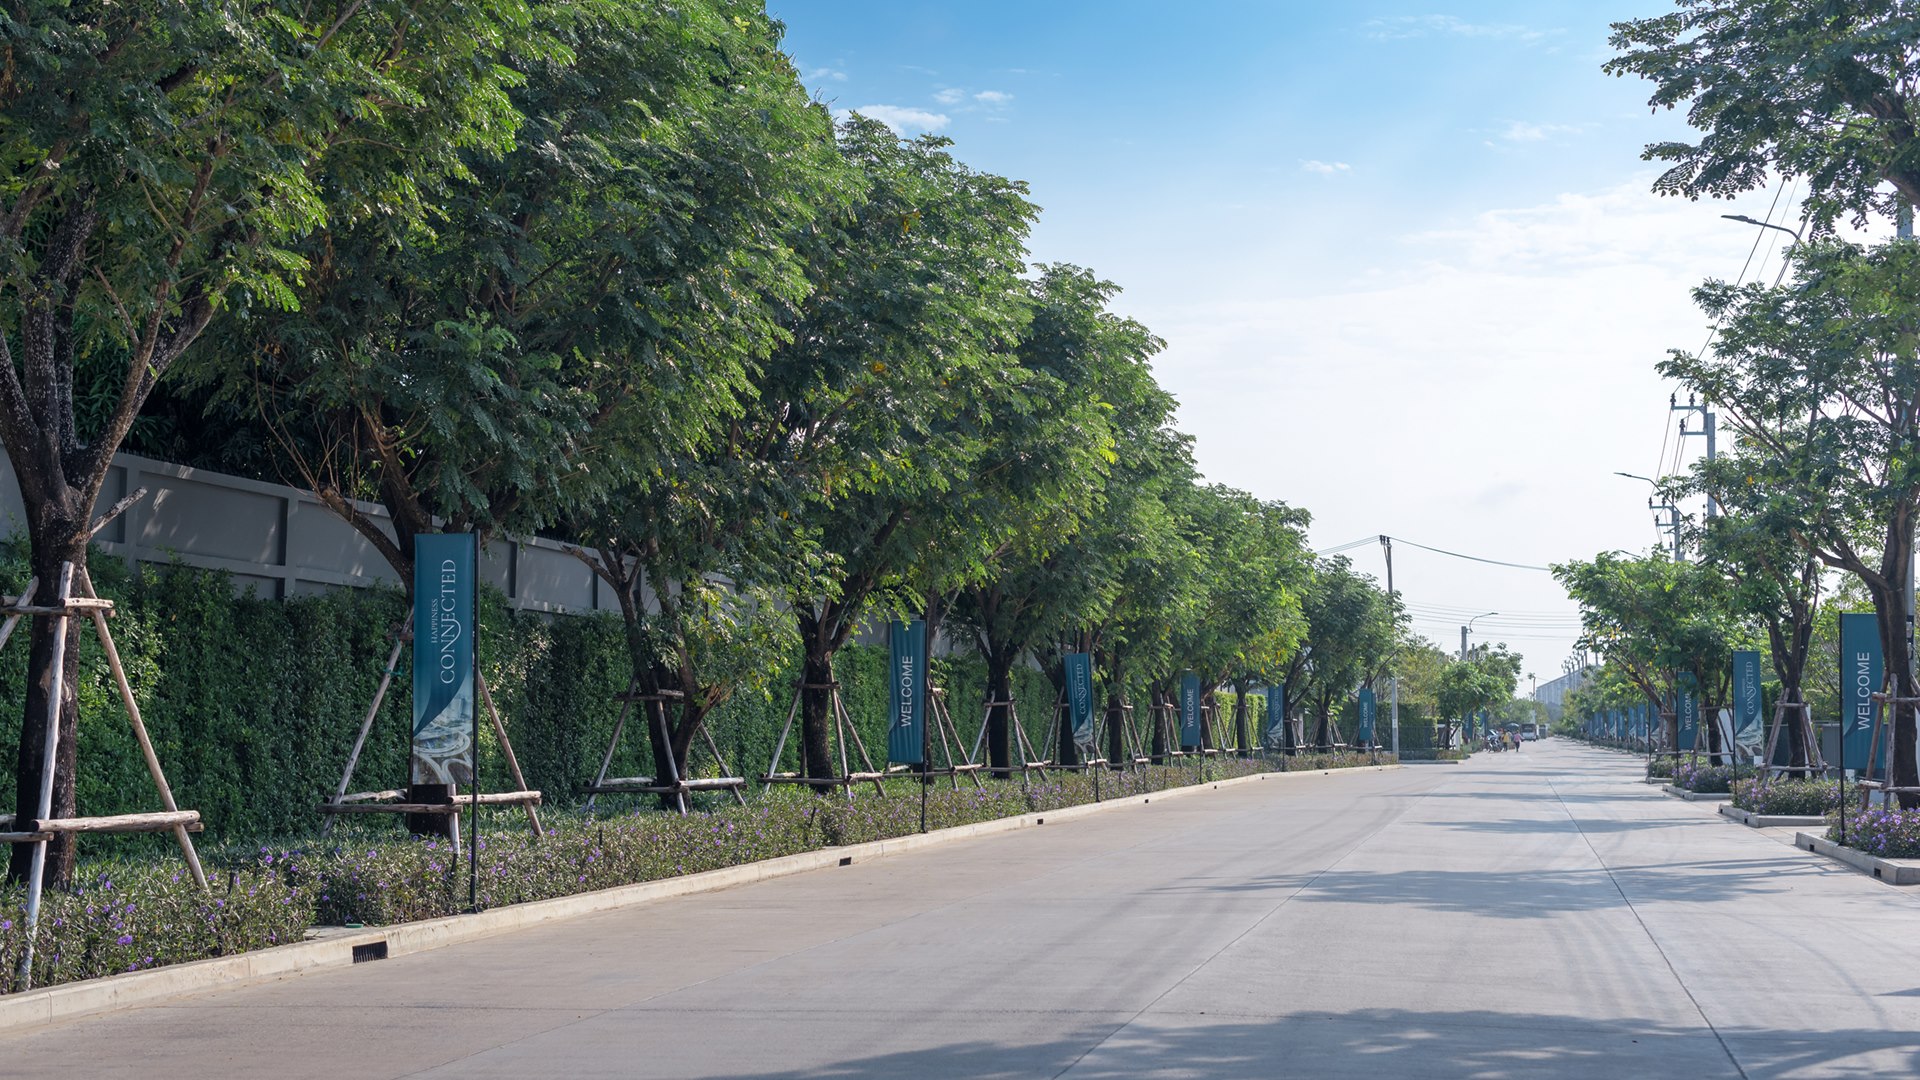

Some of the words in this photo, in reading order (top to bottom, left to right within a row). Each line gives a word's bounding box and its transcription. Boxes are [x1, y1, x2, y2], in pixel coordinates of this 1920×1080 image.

[440, 559, 461, 684] CONNECTED
[901, 656, 913, 727] WELCOME
[1745, 661, 1756, 714] CONNECTED
[1857, 652, 1870, 730] WELCOME
